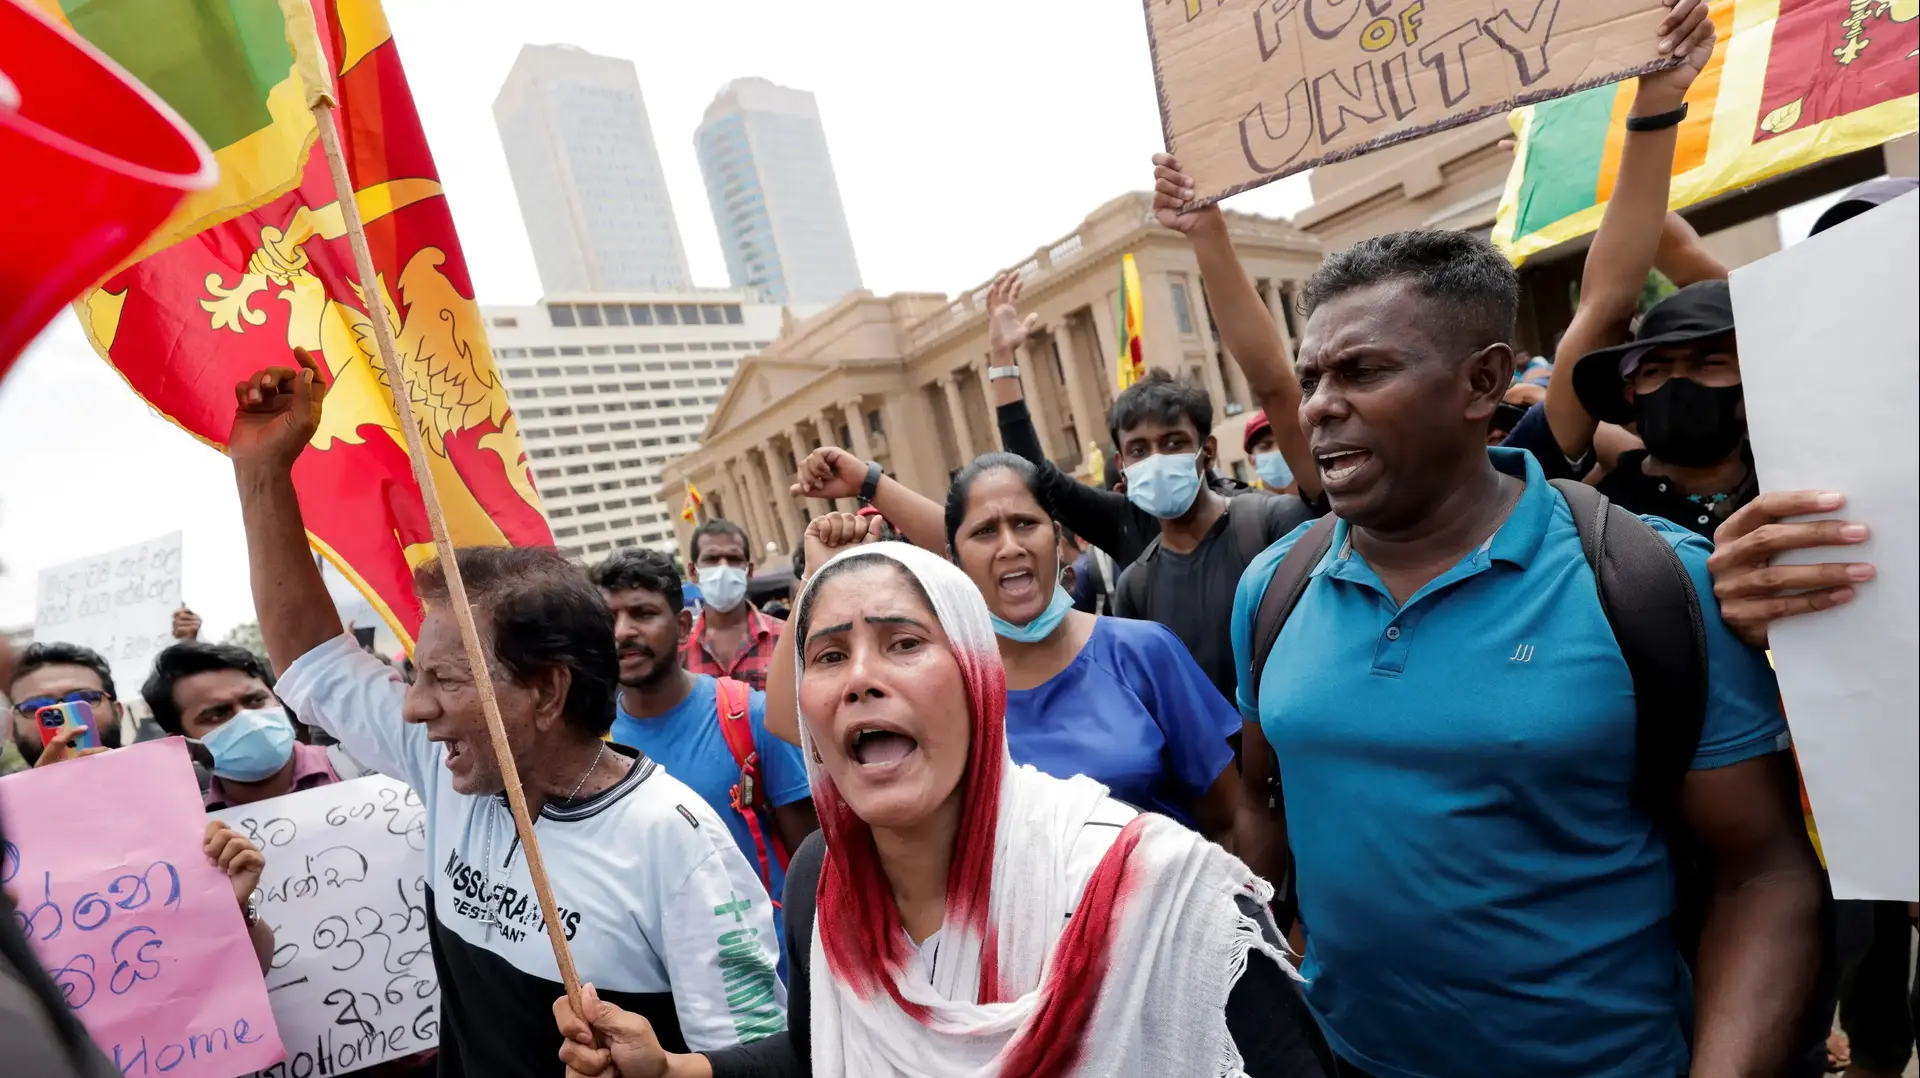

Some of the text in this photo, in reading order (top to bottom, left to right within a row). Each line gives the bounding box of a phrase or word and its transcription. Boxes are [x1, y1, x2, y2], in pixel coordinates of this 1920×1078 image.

[1359, 0, 1425, 52] OF
[1239, 0, 1560, 174] UNITY
[453, 896, 529, 944] RESTRANT
